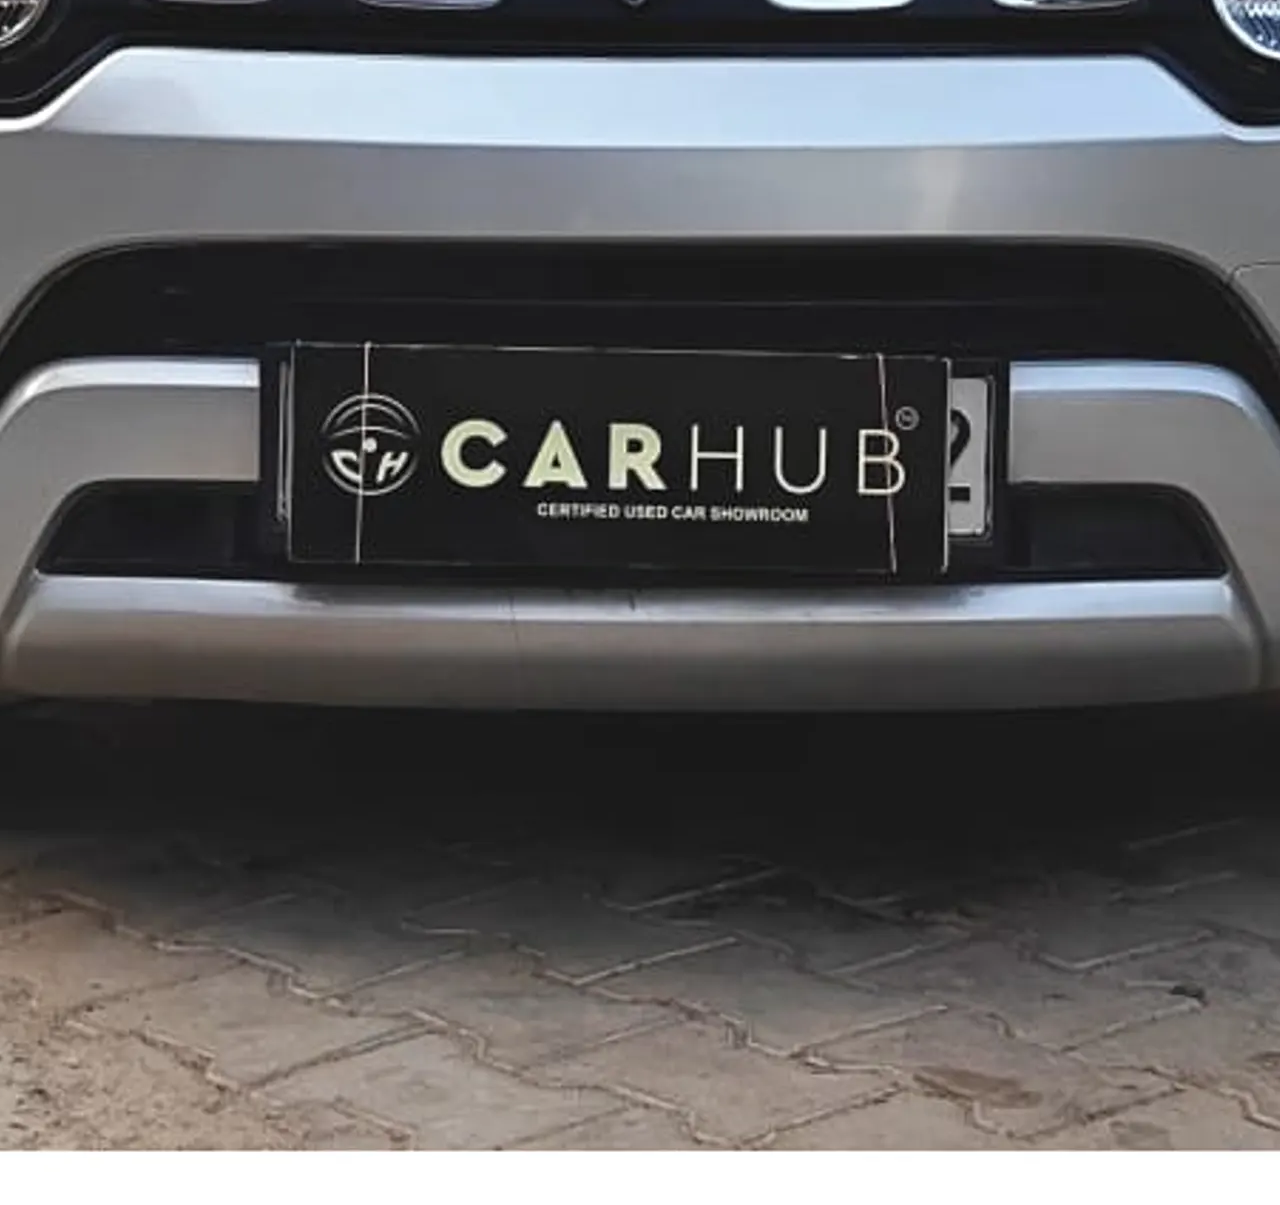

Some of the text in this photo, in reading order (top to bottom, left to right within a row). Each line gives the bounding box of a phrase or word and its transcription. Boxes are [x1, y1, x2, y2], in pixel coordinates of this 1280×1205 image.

[537, 502, 809, 522] CERTIFIED USED CAR SHOWROOM
